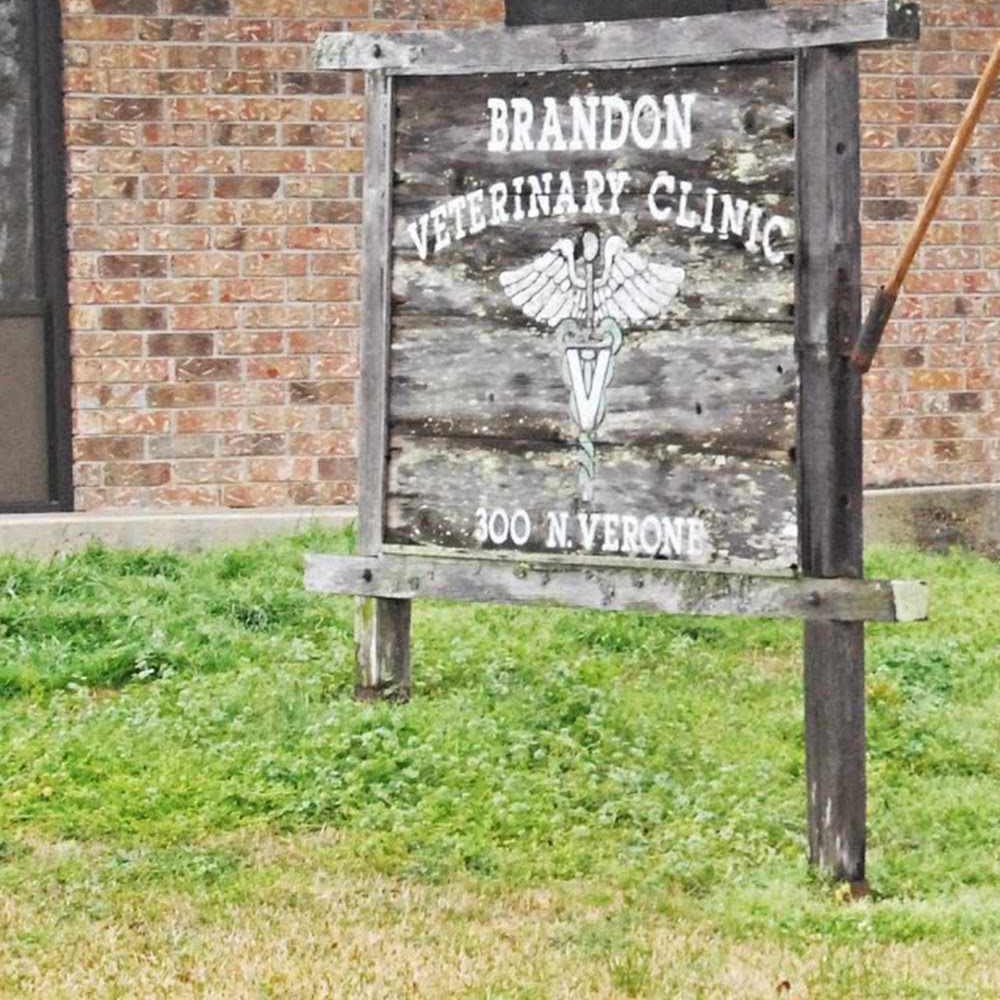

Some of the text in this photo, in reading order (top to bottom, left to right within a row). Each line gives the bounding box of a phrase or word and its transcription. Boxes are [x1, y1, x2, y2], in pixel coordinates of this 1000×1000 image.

[487, 92, 698, 152] BRANDON
[407, 169, 794, 264] VETERINARY CLINIC
[475, 506, 531, 545] 300
